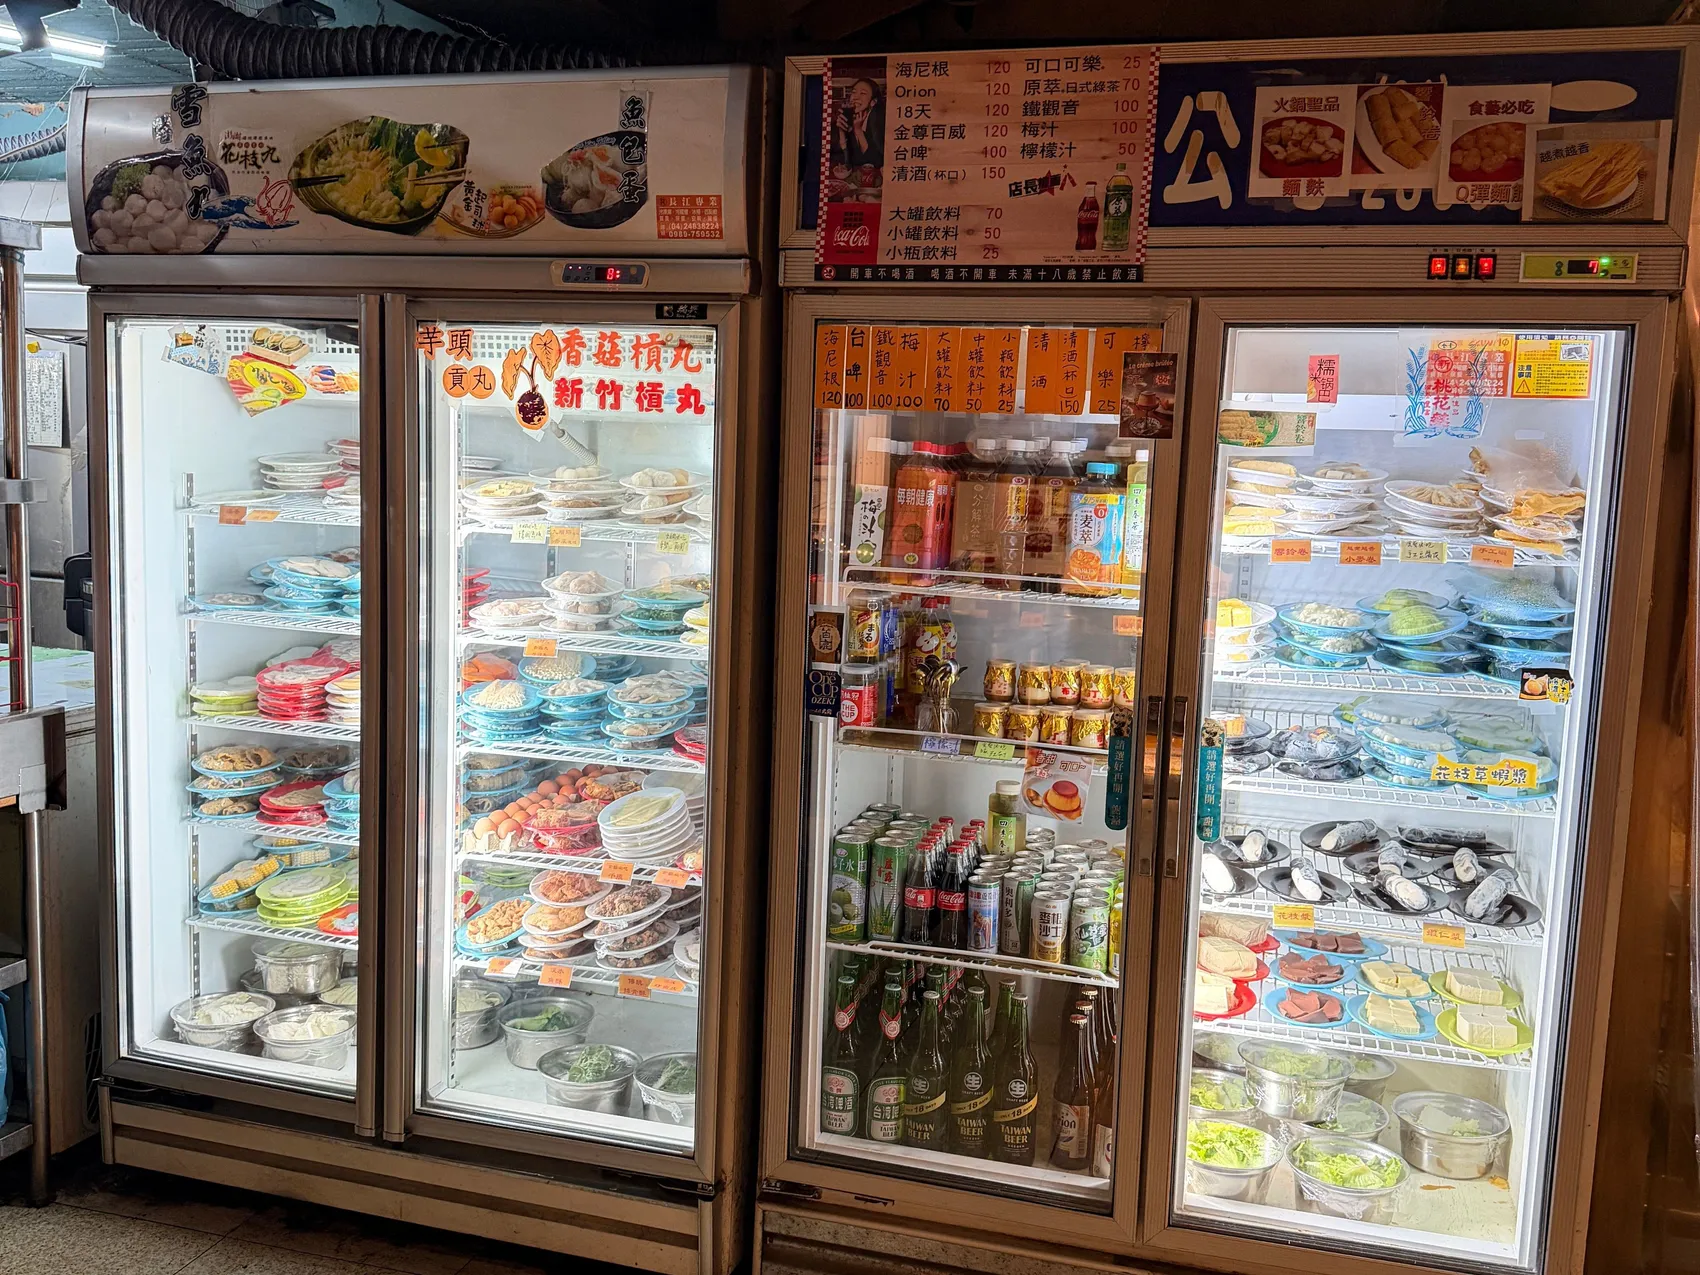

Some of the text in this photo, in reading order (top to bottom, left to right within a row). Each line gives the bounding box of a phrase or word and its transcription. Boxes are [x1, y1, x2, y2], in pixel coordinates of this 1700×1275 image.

[895, 61, 1011, 78] 海尼根 120
[1123, 56, 1141, 69] 25
[895, 82, 1010, 98] Orion 120
[1122, 78, 1140, 91] 70
[896, 103, 1009, 119] 18天 120
[1022, 99, 1139, 117] 鐵觀音 100
[1273, 96, 1340, 113] 火鍋聖品
[894, 124, 1008, 141] 金尊百威 120
[1021, 121, 1138, 137] 梅汁 100
[617, 96, 647, 204] 魚包蛋
[893, 145, 1007, 161] 台啤 100
[1020, 142, 1137, 159] 檸檬汁 50
[1163, 90, 1241, 210] 公
[1539, 142, 1590, 164] 越煮越香
[982, 167, 1006, 179] 150
[889, 206, 1003, 221] 大罐飲料 70
[887, 226, 1001, 241] 小罐飲料 50
[886, 245, 999, 260] 小瓶飲料 25
[850, 267, 1137, 280] 開車不喝酒 喝酒不開車 未滿十八歲禁止飲酒
[417, 327, 475, 361] 芋頭
[821, 329, 842, 405] 海尼根 120
[845, 327, 866, 407] 台啤 100
[872, 329, 896, 408] 鐵觀音 100
[895, 332, 923, 408] 梅汁 100
[933, 331, 953, 412] 大罐飲料 70
[965, 333, 986, 412] 中罐飲料 50
[997, 332, 1017, 412] 小瓶飲料 25
[1097, 331, 1117, 412] 可樂 25
[447, 366, 493, 393] 貢丸
[1059, 401, 1080, 414] 150
[809, 671, 837, 685] One
[811, 683, 839, 698] CUP
[811, 697, 836, 705] OZEKI
[938, 890, 966, 905] Coca-Cola
[914, 1104, 925, 1113] 18
[967, 1101, 978, 1110] 18
[1011, 1108, 1022, 1118] 18
[906, 1118, 935, 1131] TAIWAN
[957, 1117, 988, 1127] TAIWAN
[1001, 1125, 1032, 1135] TAIWAN
[907, 1128, 930, 1140] BEER
[960, 1126, 984, 1136] BEER
[1004, 1134, 1028, 1144] BEER
